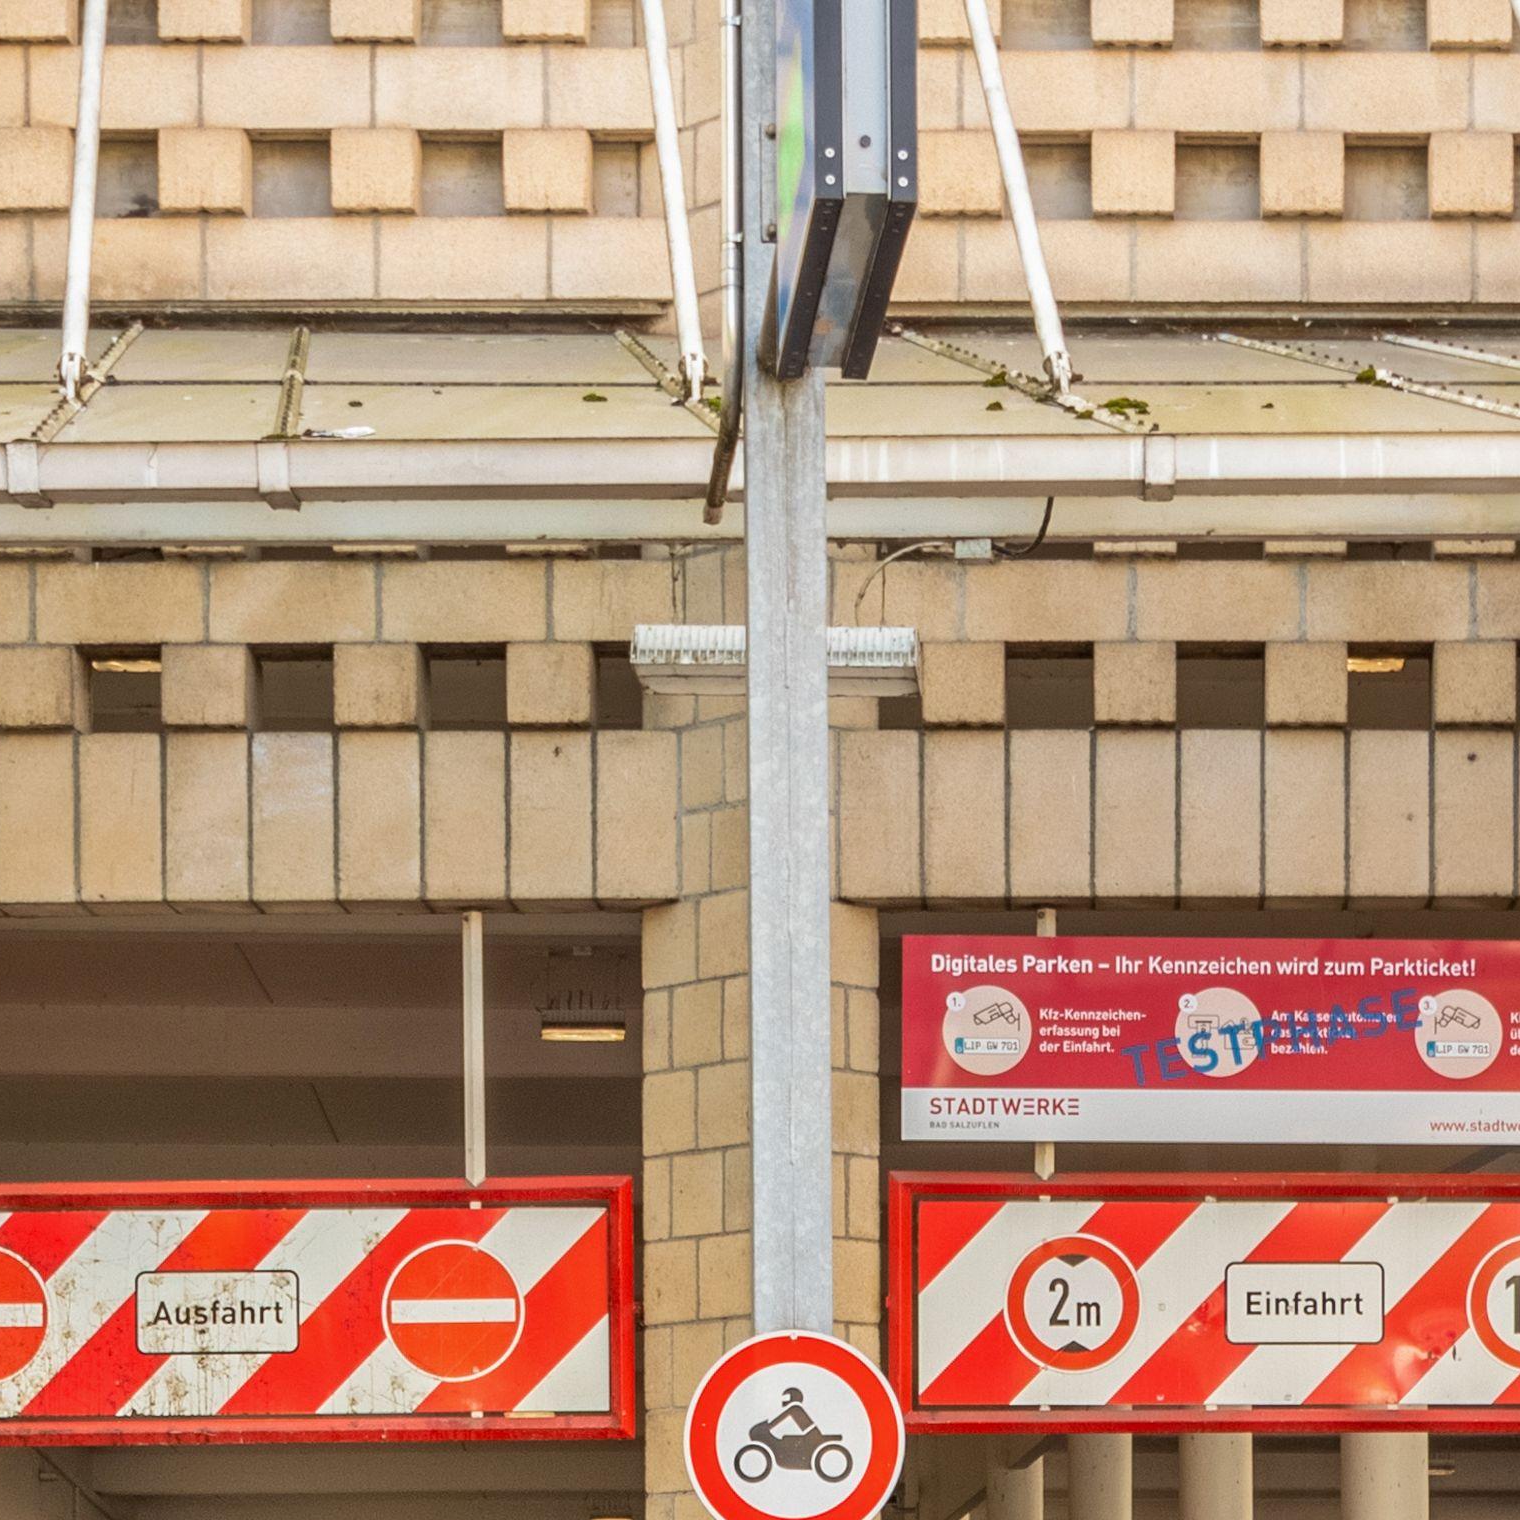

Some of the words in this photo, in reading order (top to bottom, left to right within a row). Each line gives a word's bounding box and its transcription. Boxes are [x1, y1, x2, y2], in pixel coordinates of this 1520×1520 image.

[931, 954, 1017, 976] Digitales
[1022, 955, 1092, 974] Parken
[1115, 956, 1143, 974] Ihr
[1148, 956, 1271, 975] Kennzeichen
[1276, 957, 1318, 975] wird
[1323, 960, 1364, 976] zum
[1370, 958, 1476, 977] Parkticket!
[1039, 1008, 1146, 1021] Kfz-Kennzeichen-
[1039, 1025, 1099, 1039] erfassung
[1102, 1025, 1120, 1037] bei
[1123, 988, 1423, 1086] TESTPHASE
[1039, 1041, 1059, 1052] der
[1063, 1041, 1115, 1052] Einfahrt.
[930, 1097, 1079, 1116] STADTWERKE
[949, 1121, 999, 1129] SALZUFLEN
[1245, 1289, 1365, 1317] Einfahrt
[153, 1300, 285, 1327] Ausfahrt
